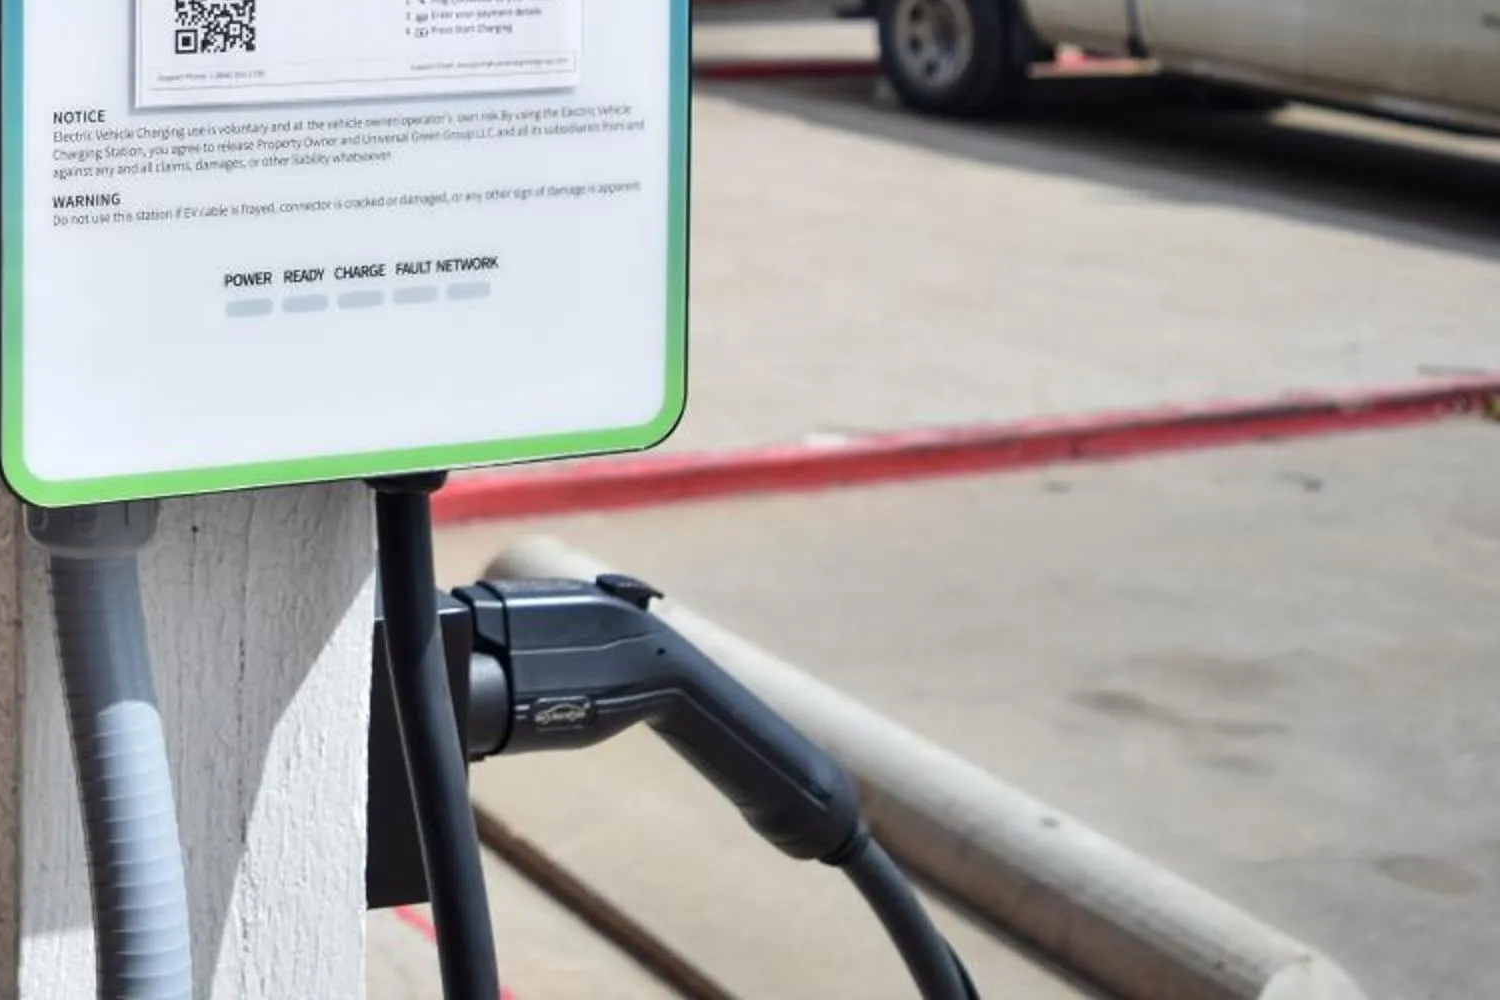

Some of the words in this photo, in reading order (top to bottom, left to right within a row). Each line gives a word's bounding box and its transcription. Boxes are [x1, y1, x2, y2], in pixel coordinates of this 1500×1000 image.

[52, 110, 107, 124] NOTICE
[52, 130, 92, 143] Electric
[95, 127, 134, 141] Vehicle
[136, 126, 185, 141] Charging
[187, 126, 204, 137] use
[207, 124, 216, 136] is
[219, 121, 268, 136] voluntary
[271, 120, 291, 132] and
[307, 118, 324, 130] the
[327, 116, 363, 129] vehicle
[597, 103, 633, 115] Vehicle
[52, 147, 103, 162] Charging
[148, 146, 169, 158] you
[171, 144, 200, 156] agree
[203, 143, 214, 153] to
[217, 139, 254, 153] release
[257, 138, 301, 151] Property
[303, 136, 336, 147] Owner
[340, 134, 360, 146] and
[362, 132, 408, 145] Universal
[411, 130, 440, 143] Green
[442, 129, 473, 142] Group
[476, 127, 495, 139] LLC
[497, 126, 515, 138] and
[544, 121, 600, 135] subsidiaries
[602, 119, 624, 131] from
[627, 118, 645, 130] and
[52, 166, 93, 180] against
[95, 166, 114, 178] any
[117, 163, 138, 175] and
[140, 161, 152, 173] all
[249, 158, 259, 167] or
[261, 155, 289, 167] other
[291, 153, 330, 167] liability
[52, 193, 121, 208] WARNING
[53, 214, 69, 226] Do
[70, 213, 89, 225] not
[91, 213, 110, 224] use
[113, 211, 132, 222] this
[135, 209, 172, 221] station
[175, 205, 183, 219] if
[184, 206, 198, 218] EV
[199, 203, 228, 217] cable
[231, 205, 239, 216] is
[279, 200, 331, 212] connector
[334, 199, 342, 209] is
[344, 195, 384, 209] cracked
[386, 197, 397, 207] or
[451, 191, 462, 202] or
[465, 191, 482, 203] any
[485, 187, 511, 200] other
[514, 186, 532, 201] sign
[535, 183, 546, 196] of
[547, 183, 586, 198] damage
[224, 272, 273, 287] POWER
[283, 269, 325, 283] READY
[334, 263, 386, 280] CHARGE
[395, 260, 432, 275] FAULT
[436, 256, 499, 272] NETWORK
